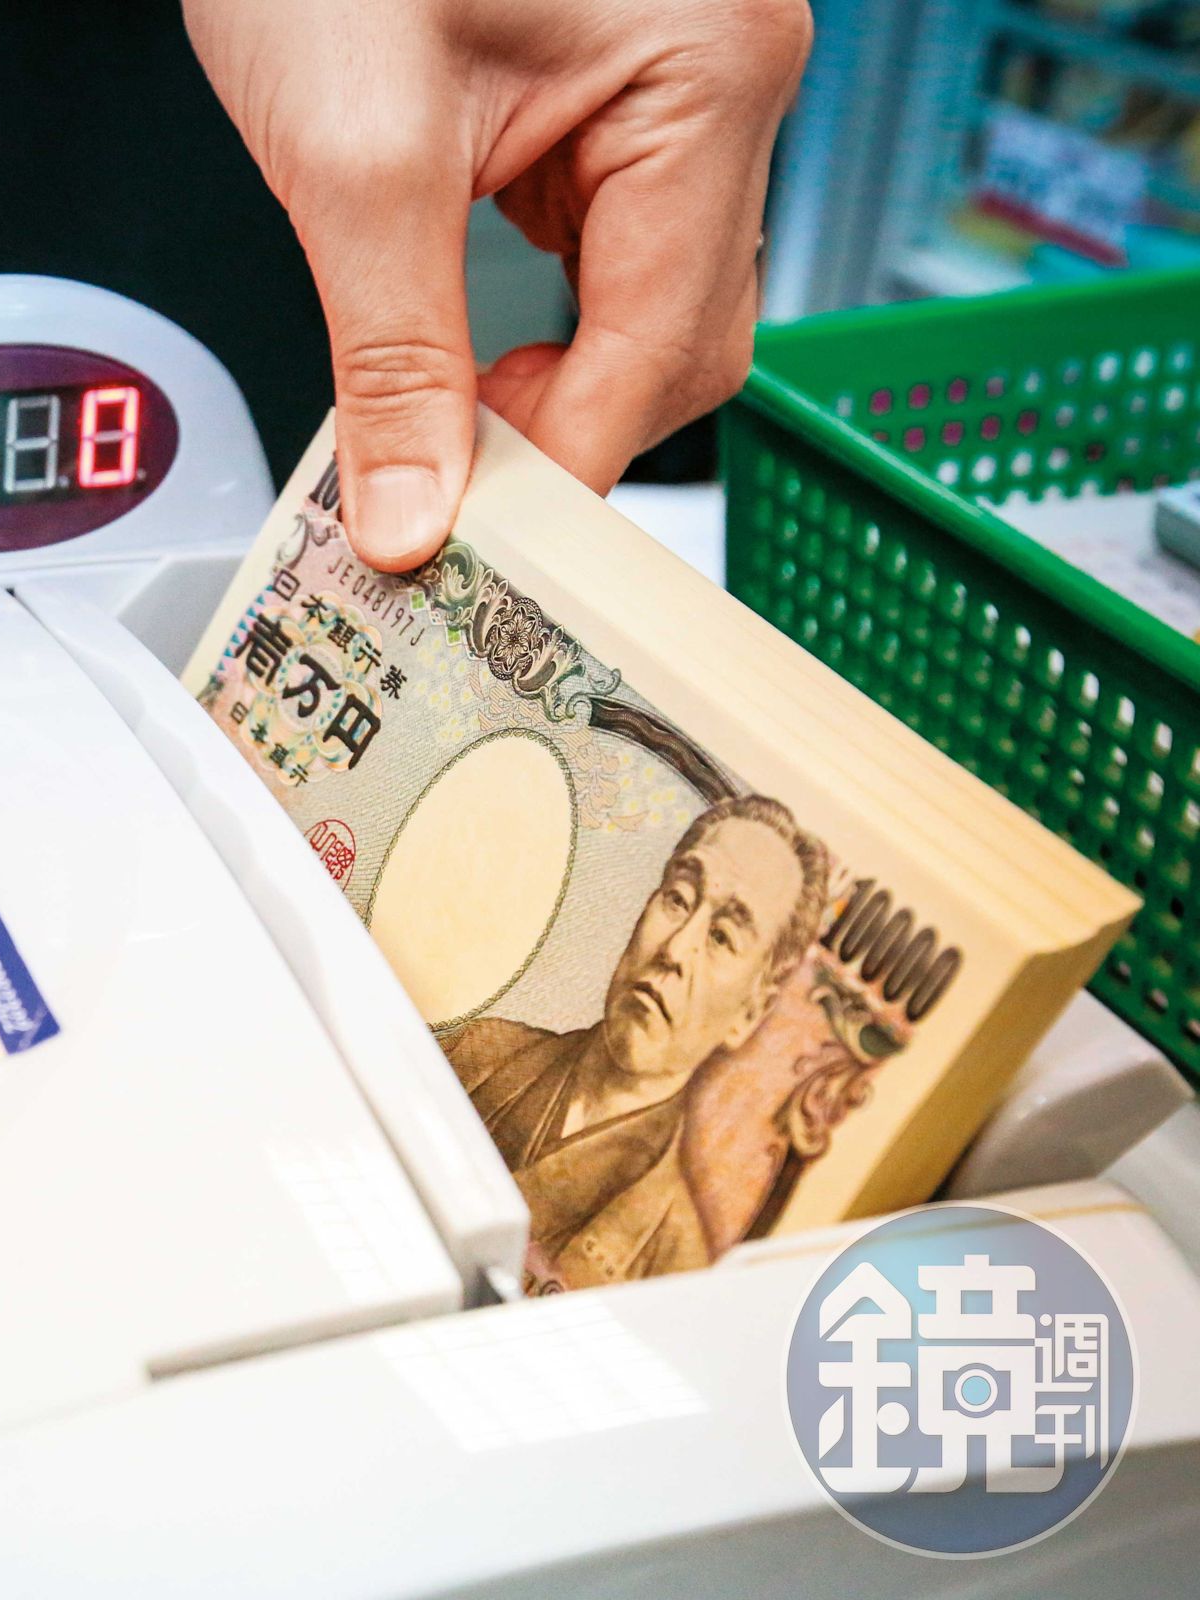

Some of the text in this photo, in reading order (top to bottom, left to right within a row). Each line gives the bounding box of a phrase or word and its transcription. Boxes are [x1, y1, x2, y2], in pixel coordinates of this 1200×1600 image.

[78, 386, 141, 489] 0
[273, 569, 408, 700] 日本銀行券
[328, 556, 426, 646] JE048197J
[819, 877, 963, 1023] 10000
